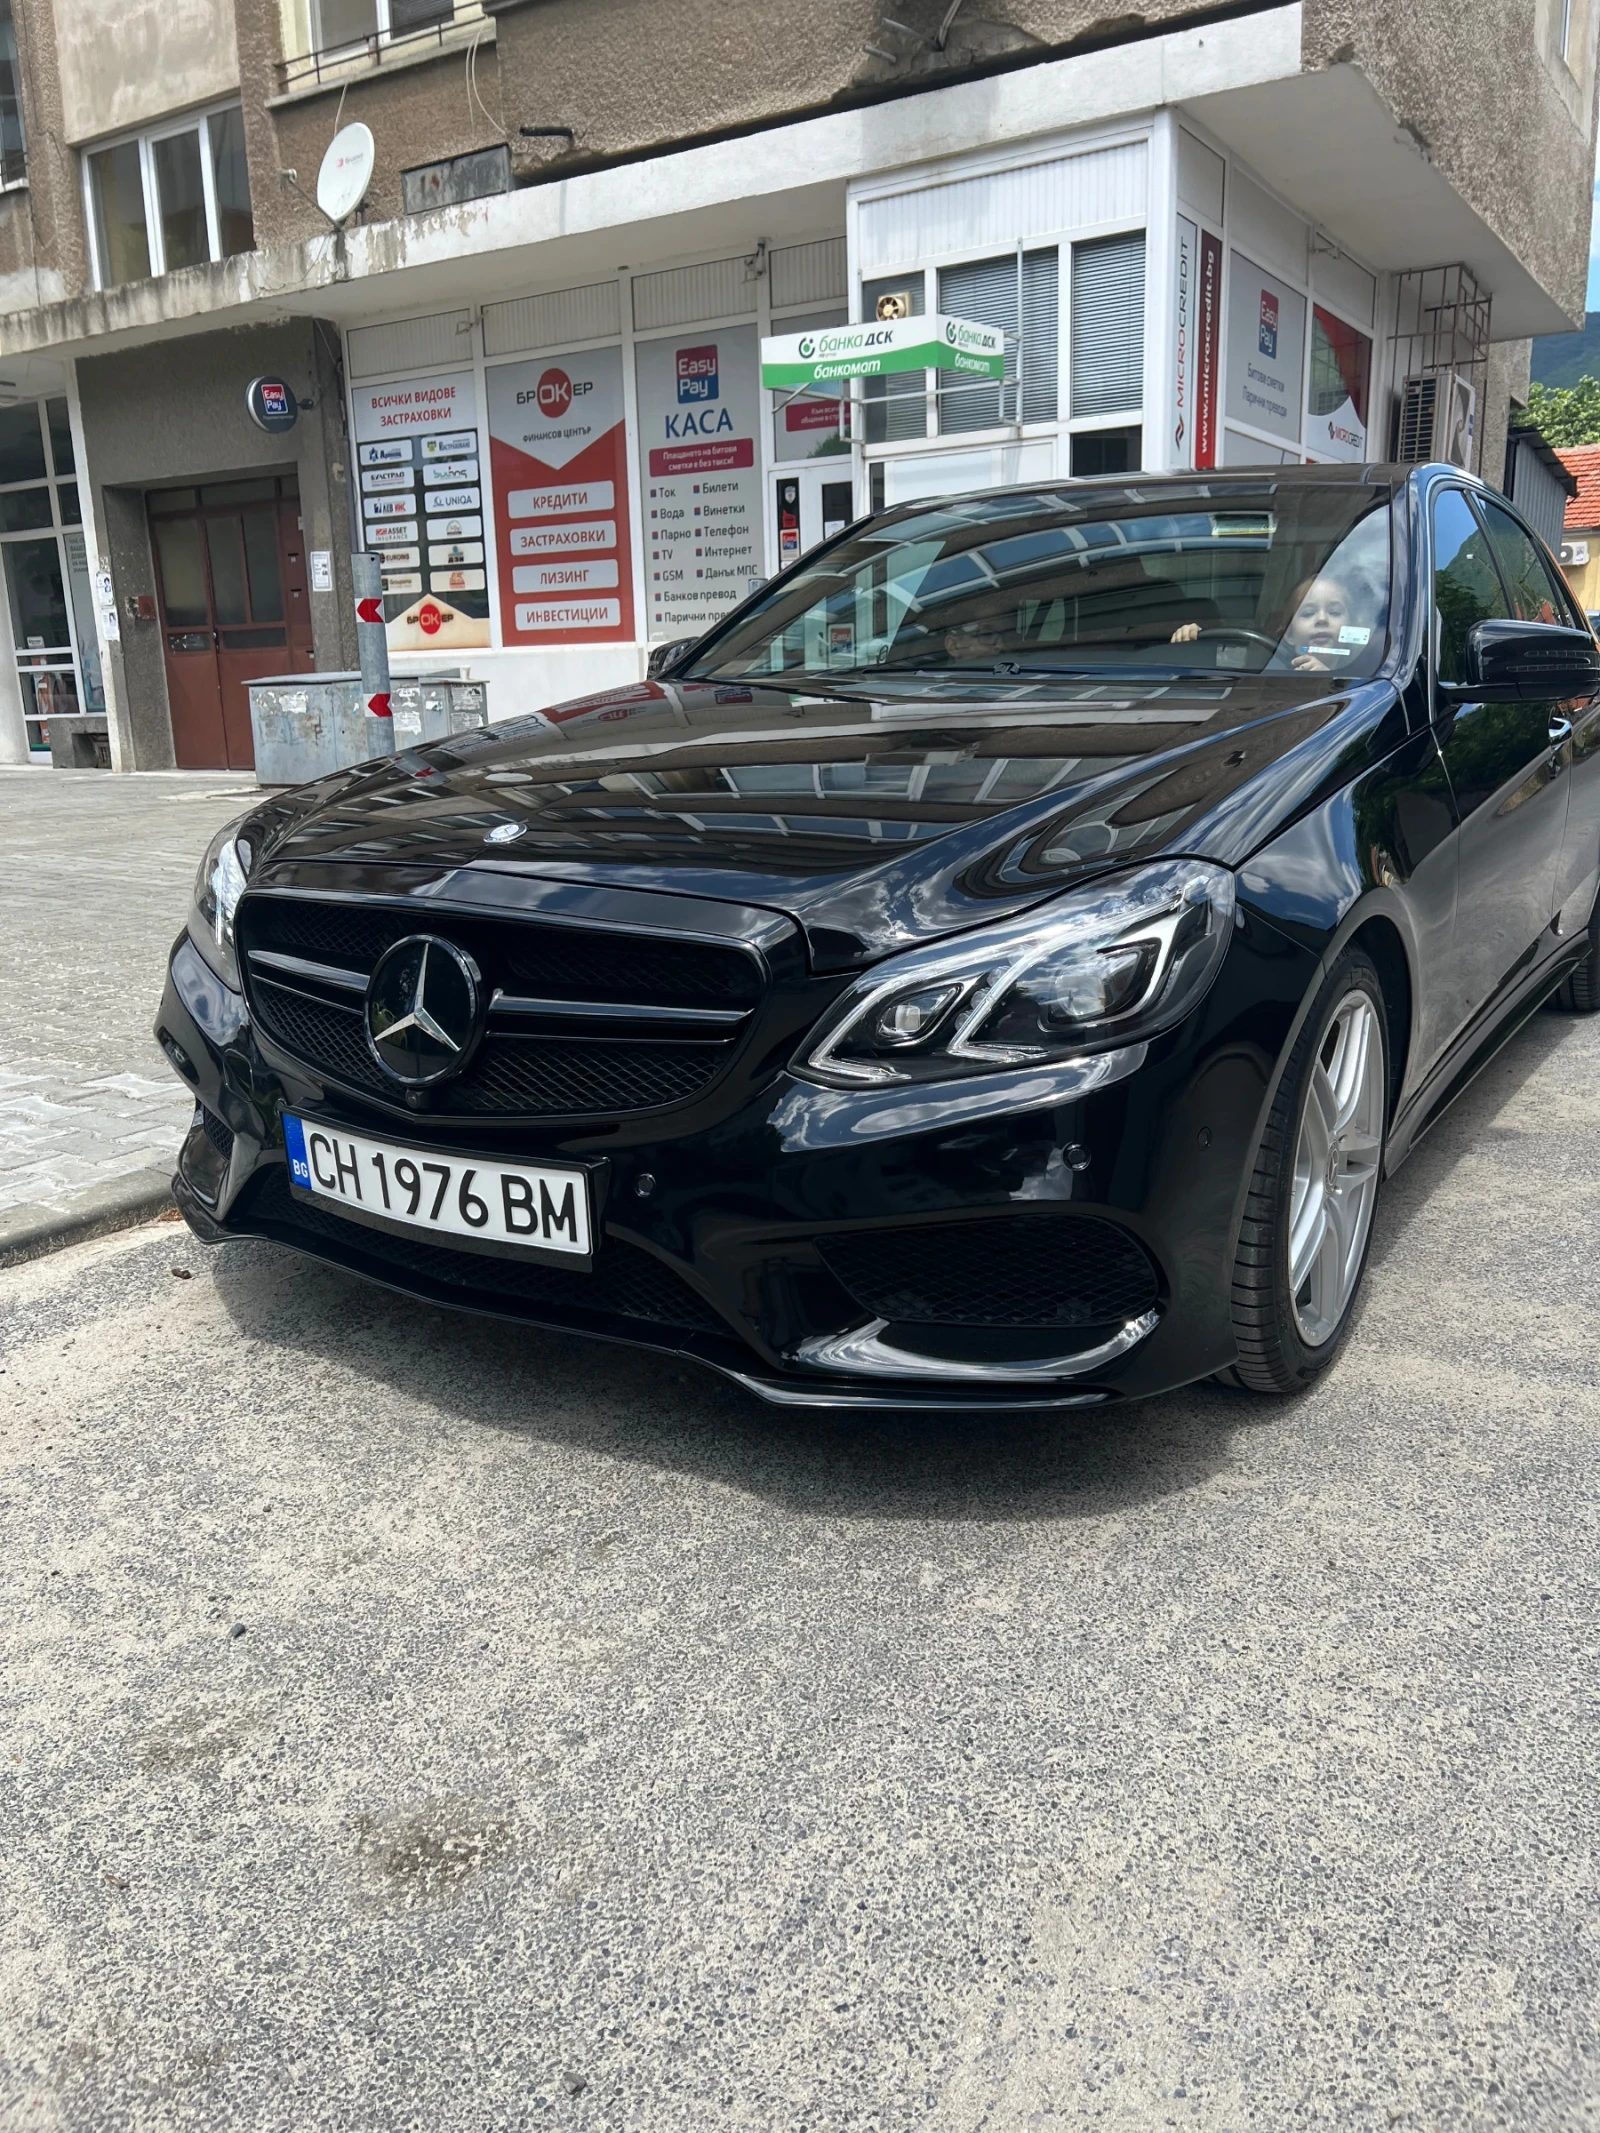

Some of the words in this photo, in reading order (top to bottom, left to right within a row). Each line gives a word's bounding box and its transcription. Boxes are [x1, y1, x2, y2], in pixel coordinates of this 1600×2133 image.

[1177, 237, 1188, 408] MICROCREDIT
[1261, 300, 1278, 331] Easy
[958, 325, 982, 345] банка
[1260, 324, 1273, 353] Pay
[819, 334, 864, 353] банка
[1202, 250, 1214, 454] www.microcredit.bg
[678, 357, 716, 376] Easy
[813, 360, 881, 379] банкомат
[955, 353, 990, 373] банкомат
[264, 390, 284, 401] Easy
[516, 381, 594, 405] БРОКЕР
[679, 378, 709, 398] Pay
[266, 400, 282, 411] Pay
[371, 392, 412, 409] ВСИЧКИ
[414, 386, 456, 404] ВИДОВЕ
[380, 407, 452, 427] ЗАСТРАХОВКИ
[665, 407, 733, 439] КАСА
[522, 429, 562, 443] ФИНАНСОВ
[563, 426, 592, 439] ЦЕНТЪР
[702, 448, 712, 456] на
[712, 445, 737, 455] битови
[668, 461, 693, 471] сметки
[698, 459, 712, 468] без
[659, 487, 676, 498] Ток
[702, 482, 739, 494] Билети
[445, 495, 473, 506] UNIQA
[533, 491, 588, 511] КРЕДИТИ
[660, 508, 684, 520] Вода
[703, 504, 745, 517] Винетки
[387, 526, 407, 534] ASSET
[661, 529, 691, 542] Парно
[704, 524, 749, 538] Телефон
[520, 529, 606, 548] ЗАСТРАХОВКИ
[662, 549, 673, 560] TV
[704, 545, 752, 559] Интернет
[540, 569, 590, 585] ЛИЗИНГ
[662, 570, 684, 581] GSM
[705, 568, 736, 580] Данък
[736, 564, 758, 576] МПС
[664, 591, 699, 602] Банков
[700, 589, 737, 603] превод
[406, 613, 454, 625] БРОКЕР
[526, 607, 608, 624] ИНВЕСТИЦИИ
[664, 611, 706, 625] Парични
[292, 1158, 309, 1178] BG
[371, 1152, 489, 1228] 1976
[499, 1173, 578, 1243] BM
